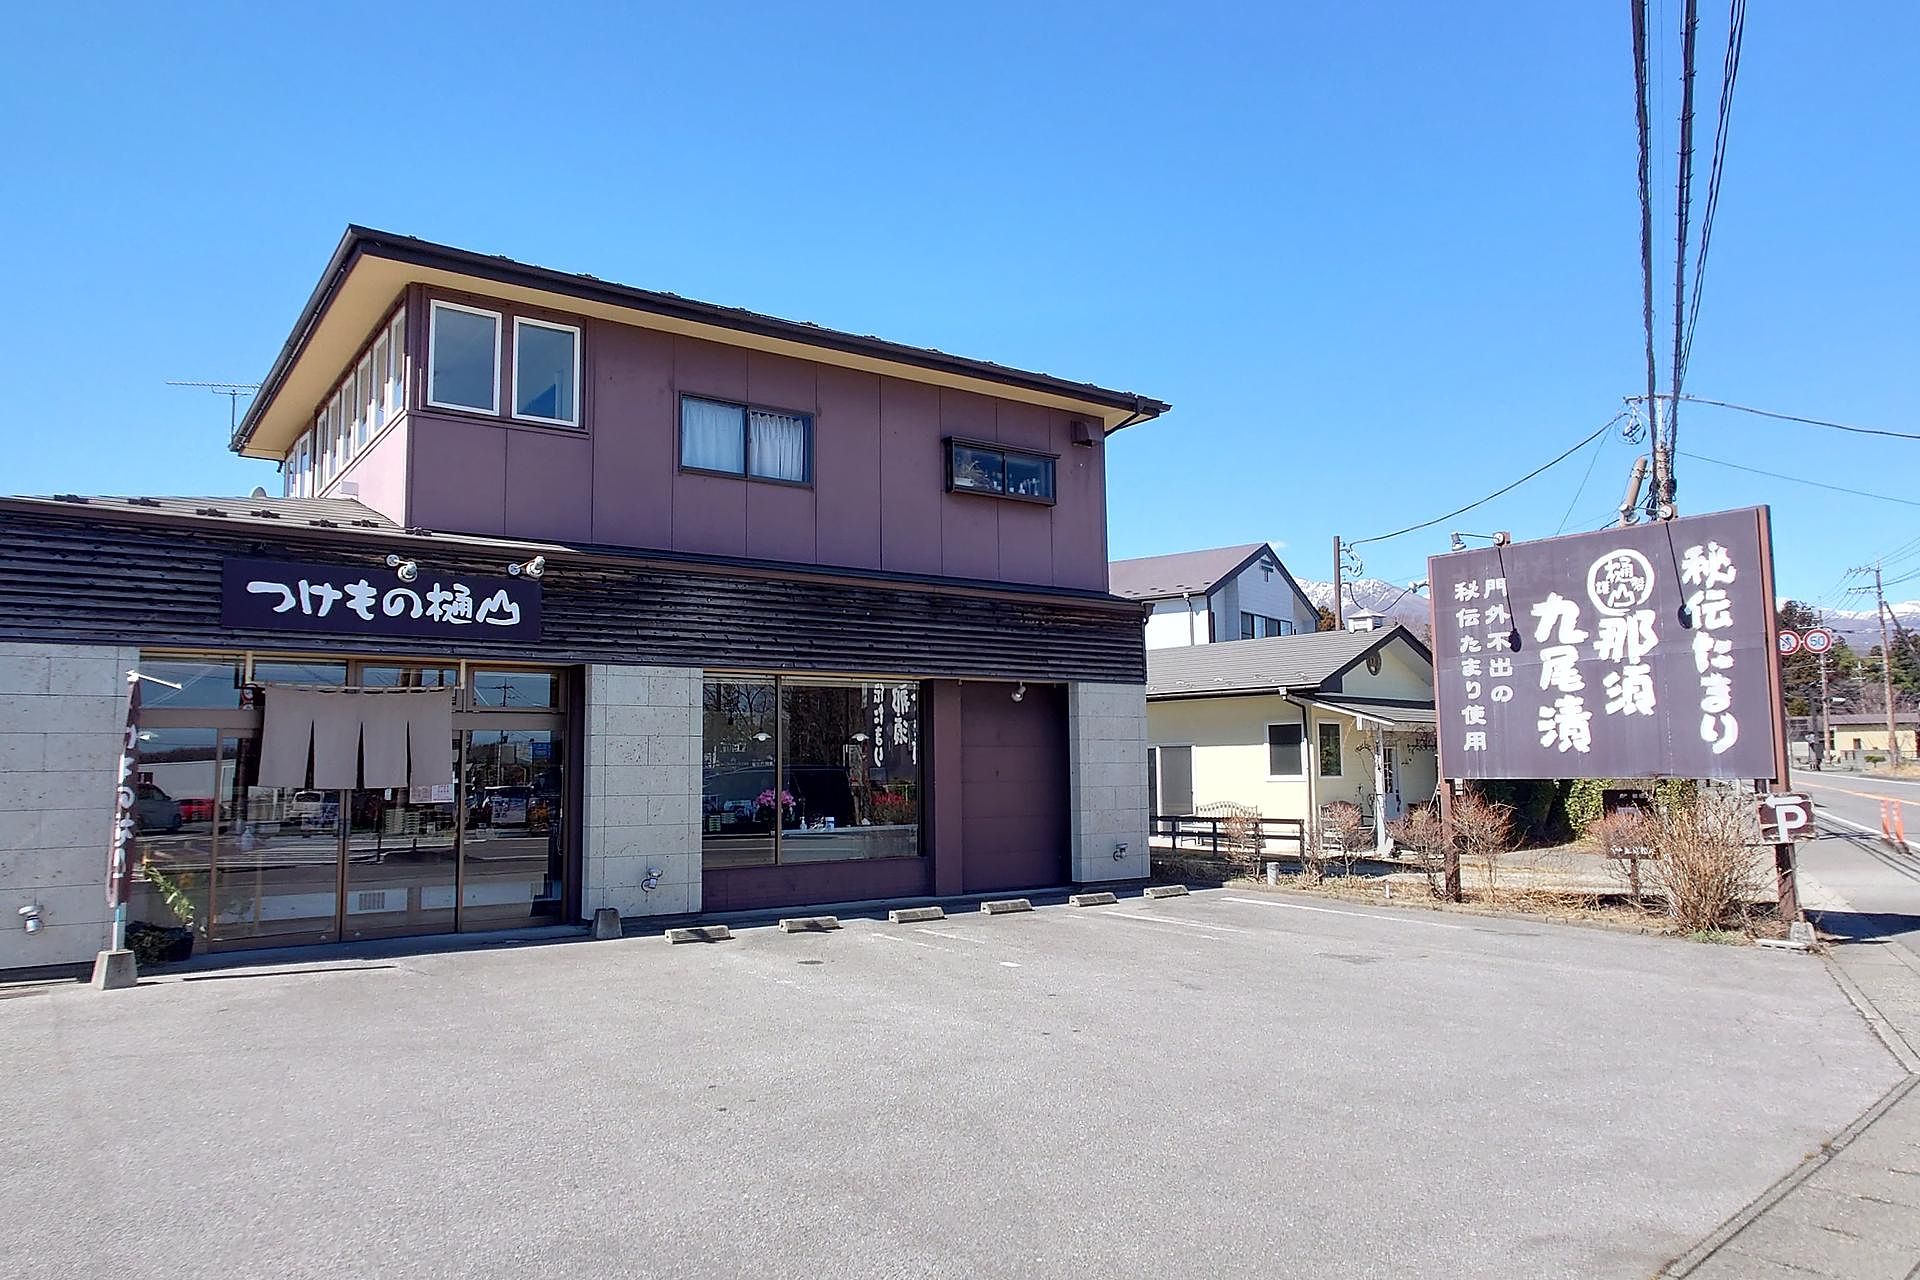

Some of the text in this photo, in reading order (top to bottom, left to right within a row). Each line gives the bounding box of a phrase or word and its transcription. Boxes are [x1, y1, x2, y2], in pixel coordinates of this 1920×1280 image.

[1454, 580, 1487, 751] 秘伝たまり使用
[1484, 578, 1513, 702] 門外不出の
[1530, 592, 1593, 753] 九尾漬
[1593, 609, 1659, 716] 那須
[1682, 541, 1739, 754] 秘伝たまり
[1810, 635, 1826, 647] 50
[1775, 804, 1808, 844] P
